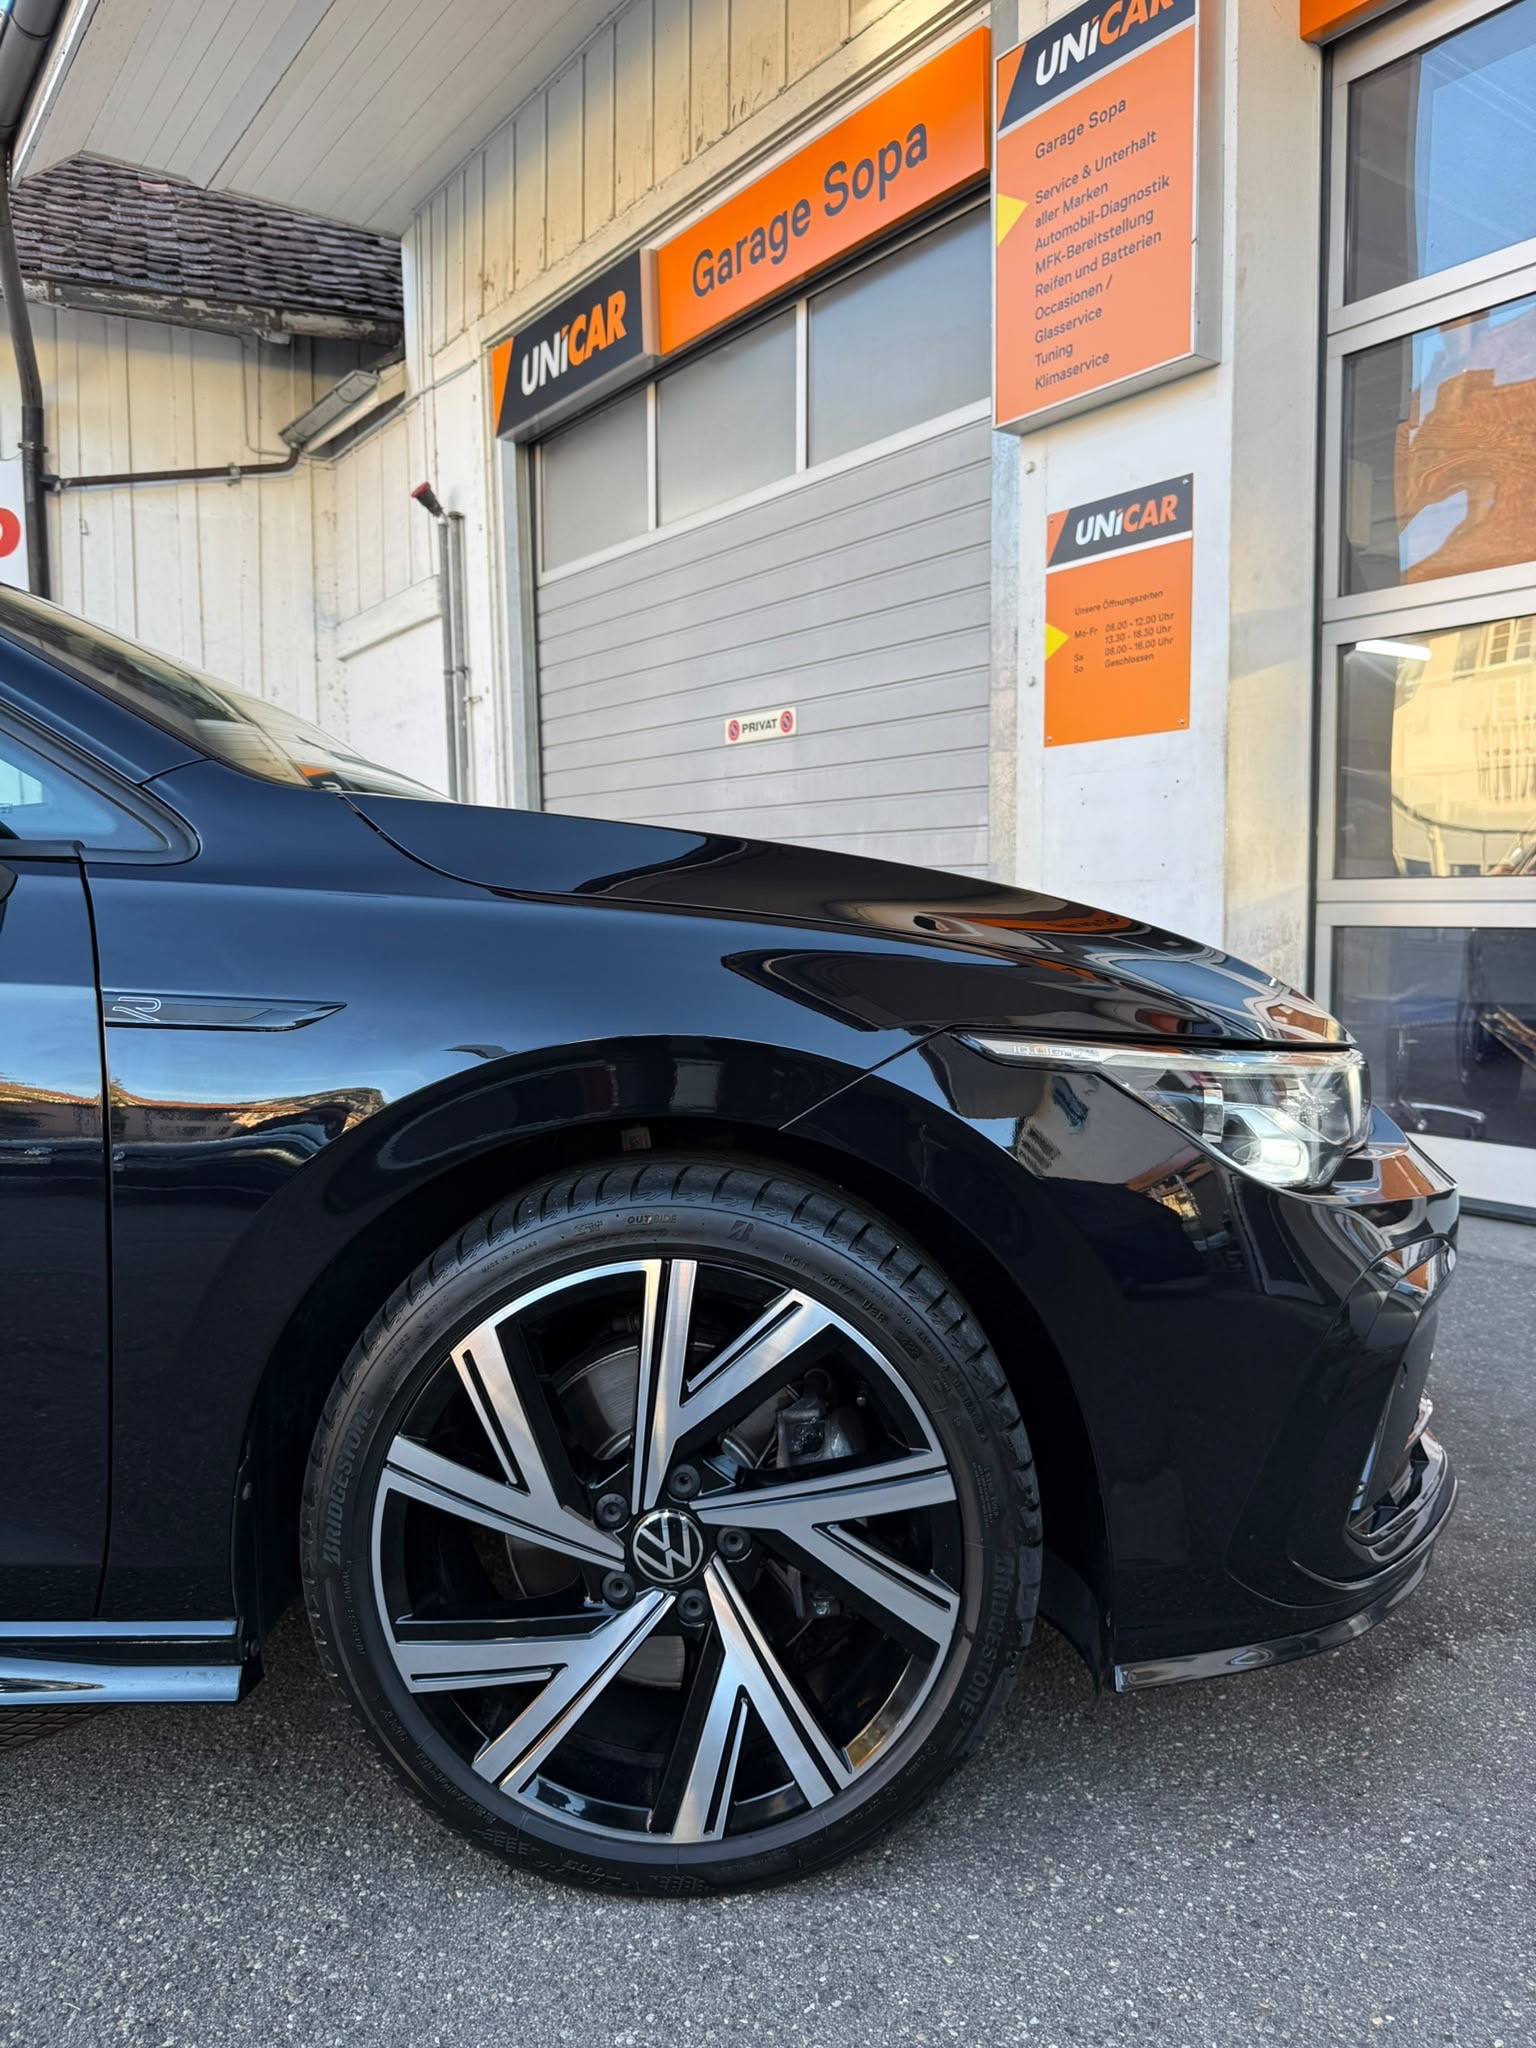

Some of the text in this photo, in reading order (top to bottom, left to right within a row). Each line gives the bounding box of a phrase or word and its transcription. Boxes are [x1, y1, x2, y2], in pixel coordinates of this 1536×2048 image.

[1035, 99, 1126, 159] Garage Sopa
[1035, 131, 1156, 204] Service & Unterhalt
[692, 123, 928, 298] Garage Sopa
[1035, 182, 1108, 228] aller Marken
[1035, 175, 1170, 251] Automobil-Diagnostik
[1035, 209, 1154, 275] MFK-Bereitstellung
[1035, 231, 1162, 298] Reifen und Batterien
[1035, 273, 1113, 320] Occasionen /
[1035, 307, 1102, 344] Glasservice
[1035, 343, 1073, 367] Tuning
[1035, 352, 1109, 390] Klimaservice
[1074, 591, 1164, 616] Unsere Öffnungszeiten
[1074, 627, 1098, 639] Mo-Fr
[1105, 620, 1127, 633] 08.00
[1135, 614, 1156, 627] 12.00
[1158, 612, 1174, 622] Uhr
[1073, 653, 1084, 662] Sa
[1157, 637, 1174, 646] Uhr
[1156, 625, 1172, 635] Uhr
[1073, 653, 1154, 674] So Geschlossen
[742, 718, 777, 733] PRIVAT
[321, 1403, 374, 1567] BRIDGESTONE
[960, 1550, 1017, 1714] BRIDGESTONE
